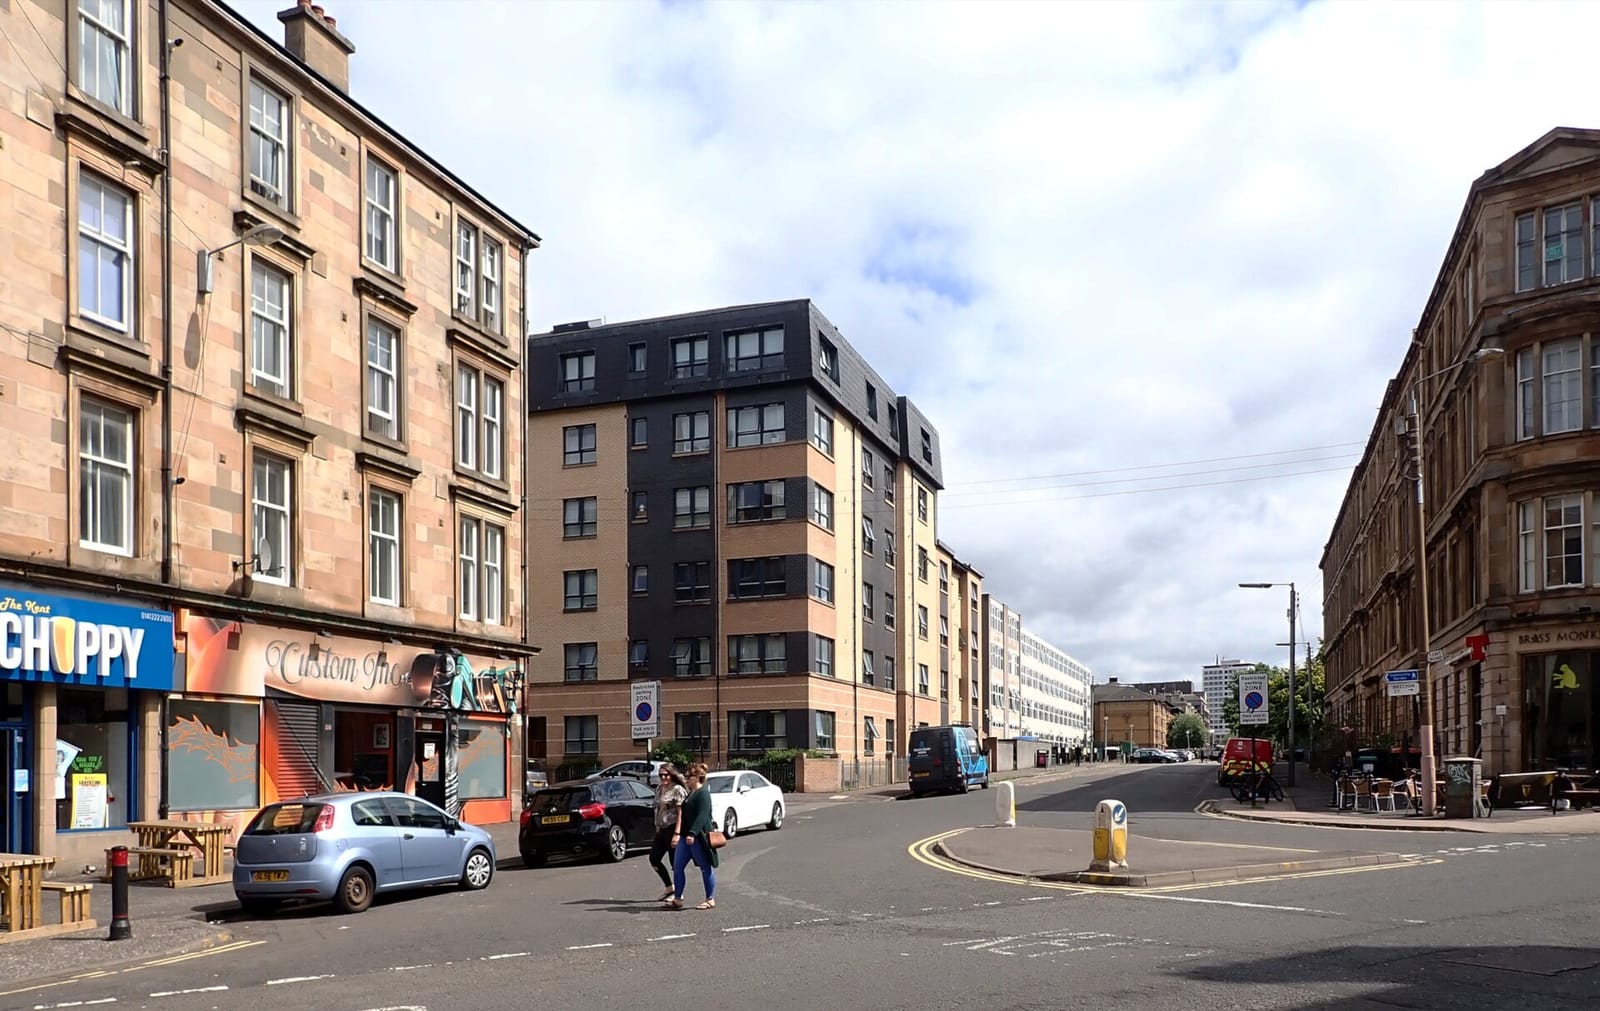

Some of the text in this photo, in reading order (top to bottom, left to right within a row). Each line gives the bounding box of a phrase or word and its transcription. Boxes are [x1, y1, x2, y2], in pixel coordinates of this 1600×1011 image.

[0, 598, 51, 614] The Kent
[1518, 632, 1551, 644] BRASS
[1557, 630, 1600, 642] MONK
[265, 640, 358, 684] Custom
